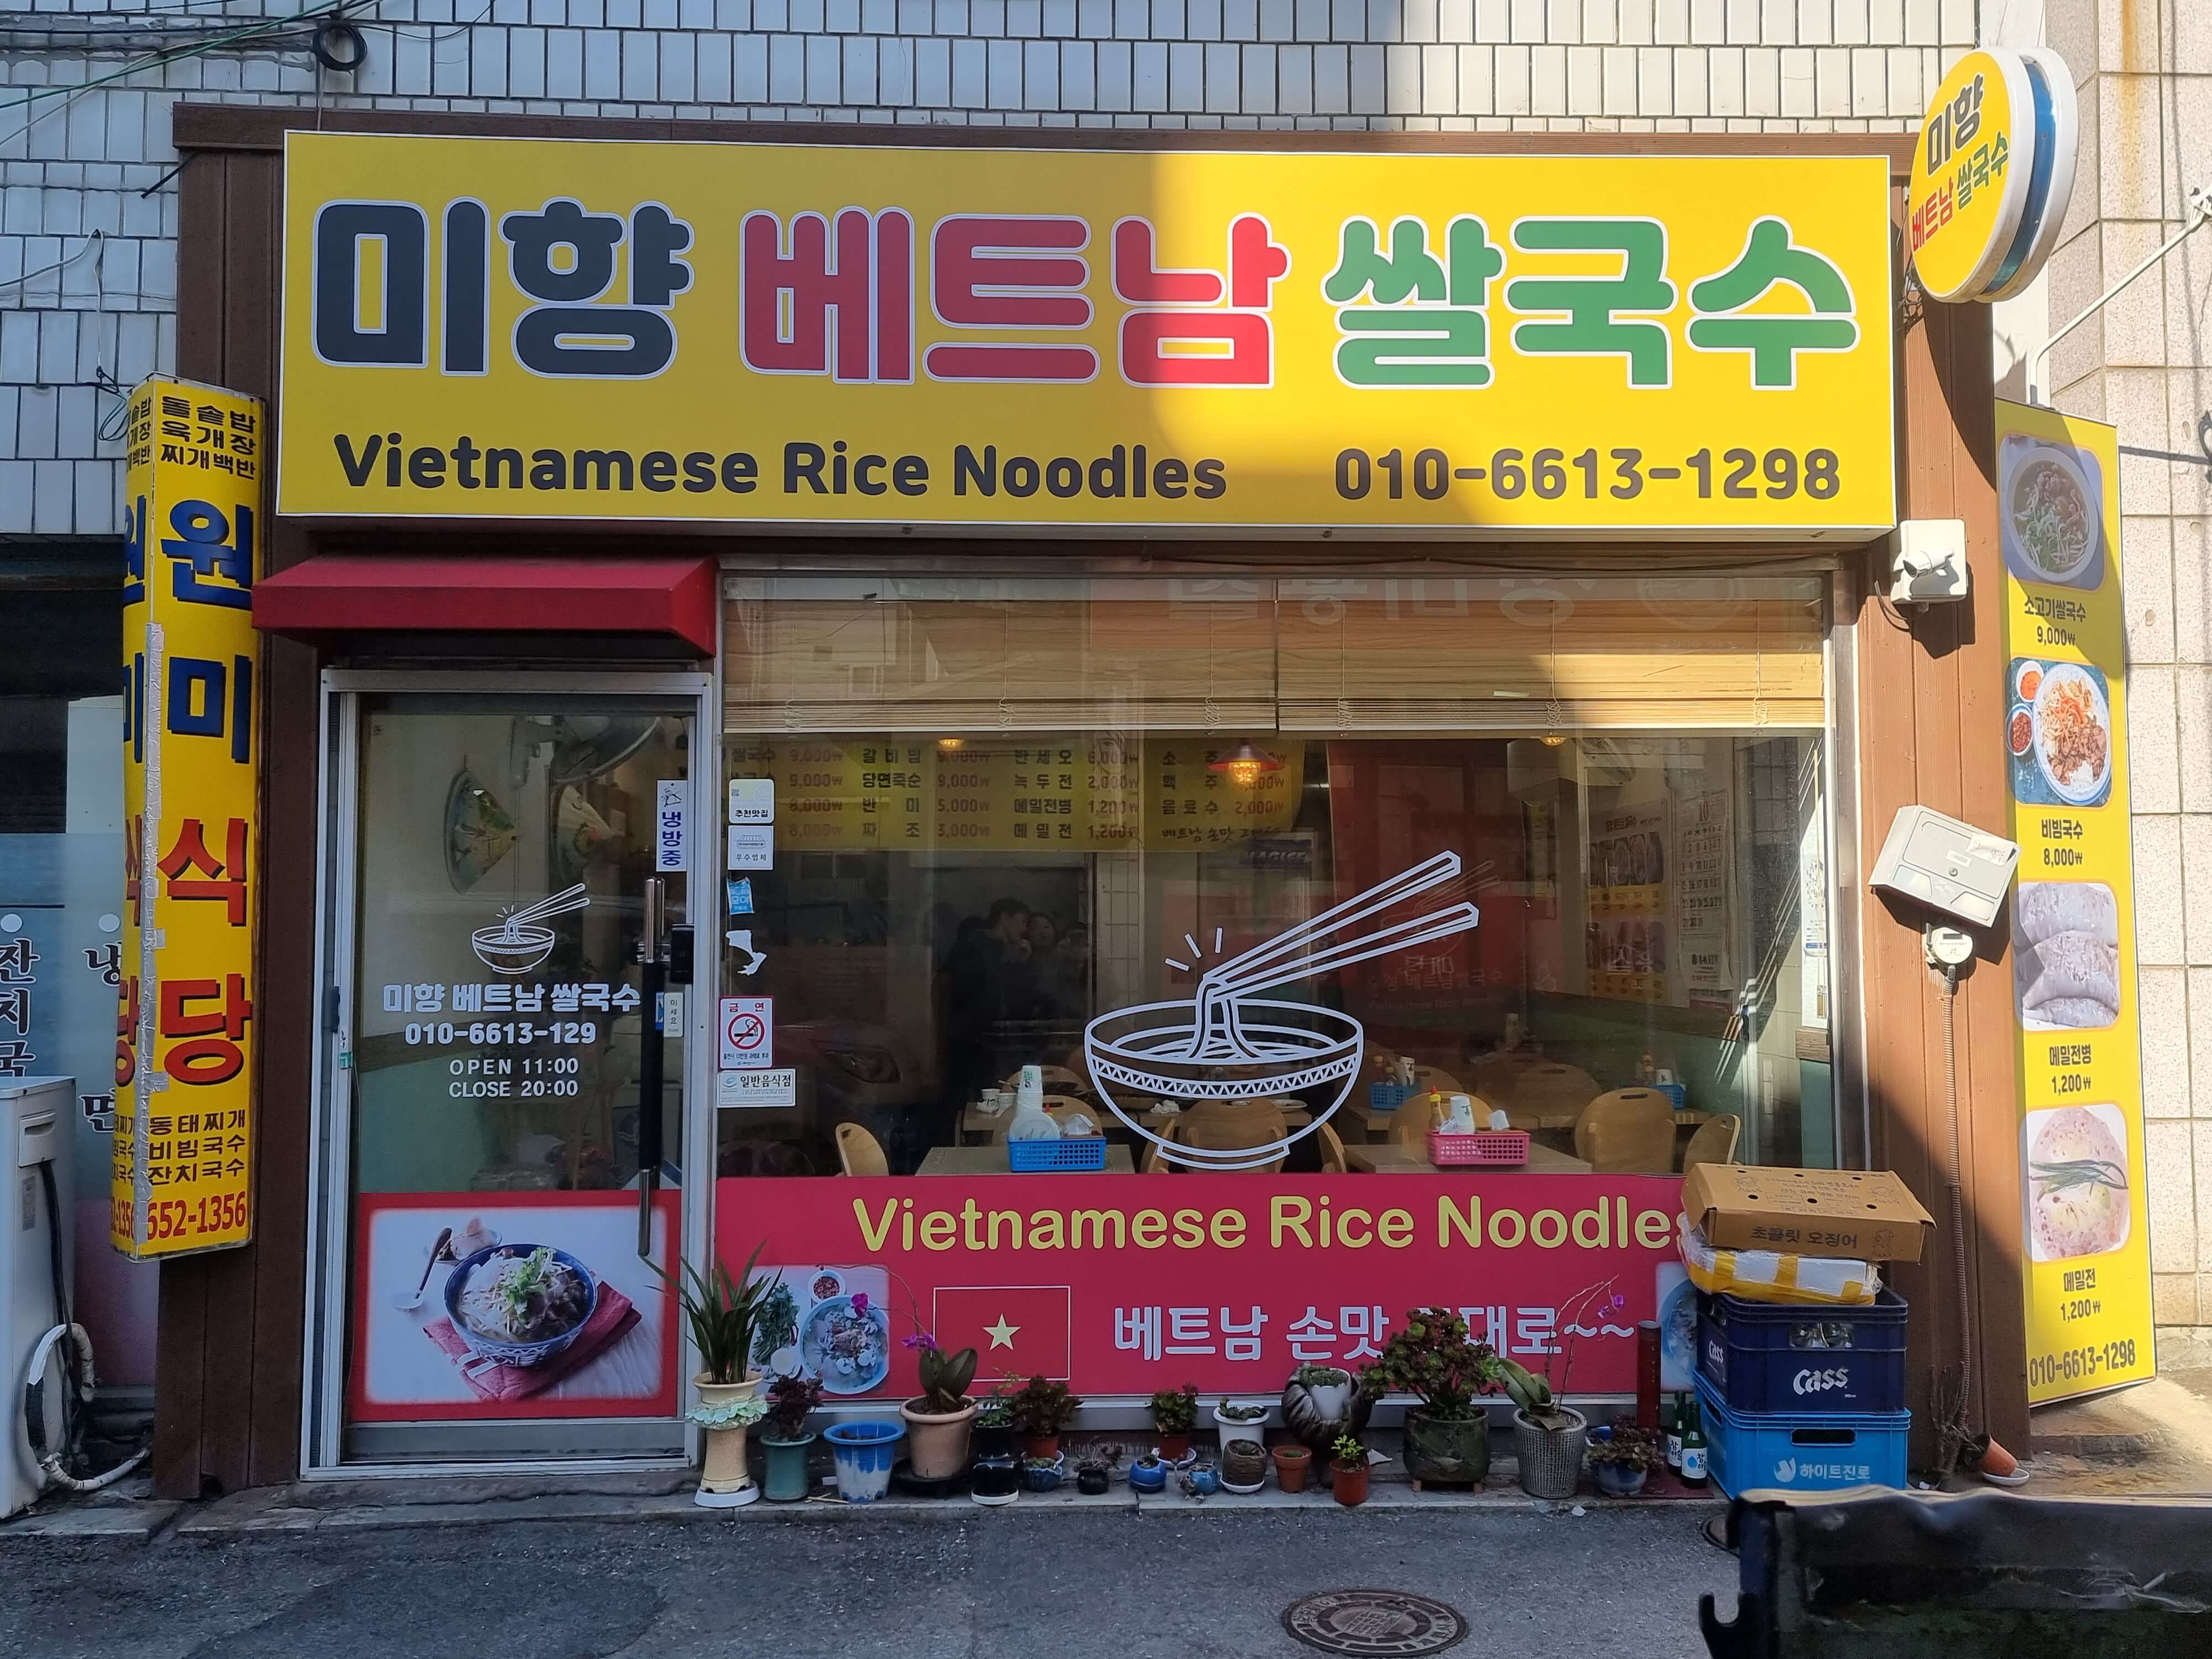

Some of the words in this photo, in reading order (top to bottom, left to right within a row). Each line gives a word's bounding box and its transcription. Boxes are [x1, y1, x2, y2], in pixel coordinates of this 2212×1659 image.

[1927, 72, 1984, 176] 미향
[1912, 175, 1954, 252] 베트남
[1957, 131, 2010, 210] 쌀국수
[313, 197, 695, 378] 미향
[740, 205, 1291, 389] 베트남
[1320, 211, 1861, 391] 쌀국수
[161, 444, 255, 480] 찌개백반
[333, 434, 758, 495] Vietnamese
[783, 441, 930, 497] Rice
[953, 444, 1227, 499] Noodles
[1335, 448, 1841, 500] 010-6613-1298
[2025, 595, 2086, 624] 소고기쌀국수
[734, 810, 769, 818] 추천맛집
[662, 811, 682, 867] 냉방중
[2041, 818, 2084, 840] 비빔국수
[735, 853, 768, 862] 우수업체
[383, 983, 445, 1012] 미향
[452, 983, 545, 1012] 베트남
[550, 983, 641, 1012] 쌀국수
[670, 999, 678, 1025] 미세요
[405, 1022, 597, 1045] 010-6613-129
[449, 1058, 512, 1076] OPEN
[521, 1057, 579, 1074] 11:00
[2049, 1044, 2092, 1067] 메밀전병
[448, 1081, 511, 1098] CLOSE
[521, 1079, 579, 1097] 20:00
[740, 1074, 791, 1088] 일반음식점
[149, 1109, 246, 1135] 동태찌개
[149, 1134, 246, 1161] 비빔국수
[148, 1158, 245, 1186] 잔치국수
[852, 1197, 1247, 1252] Vietnamese
[1270, 1194, 1415, 1249] Rice
[1807, 1232, 1859, 1249] 오징어
[2063, 1267, 2096, 1292] 메밀전
[1114, 1305, 1269, 1361] 베트남
[1286, 1306, 1390, 1360] 손맛
[2030, 1338, 2136, 1387] 010-6613-1298
[1799, 1463, 1871, 1481] 하이트진로
